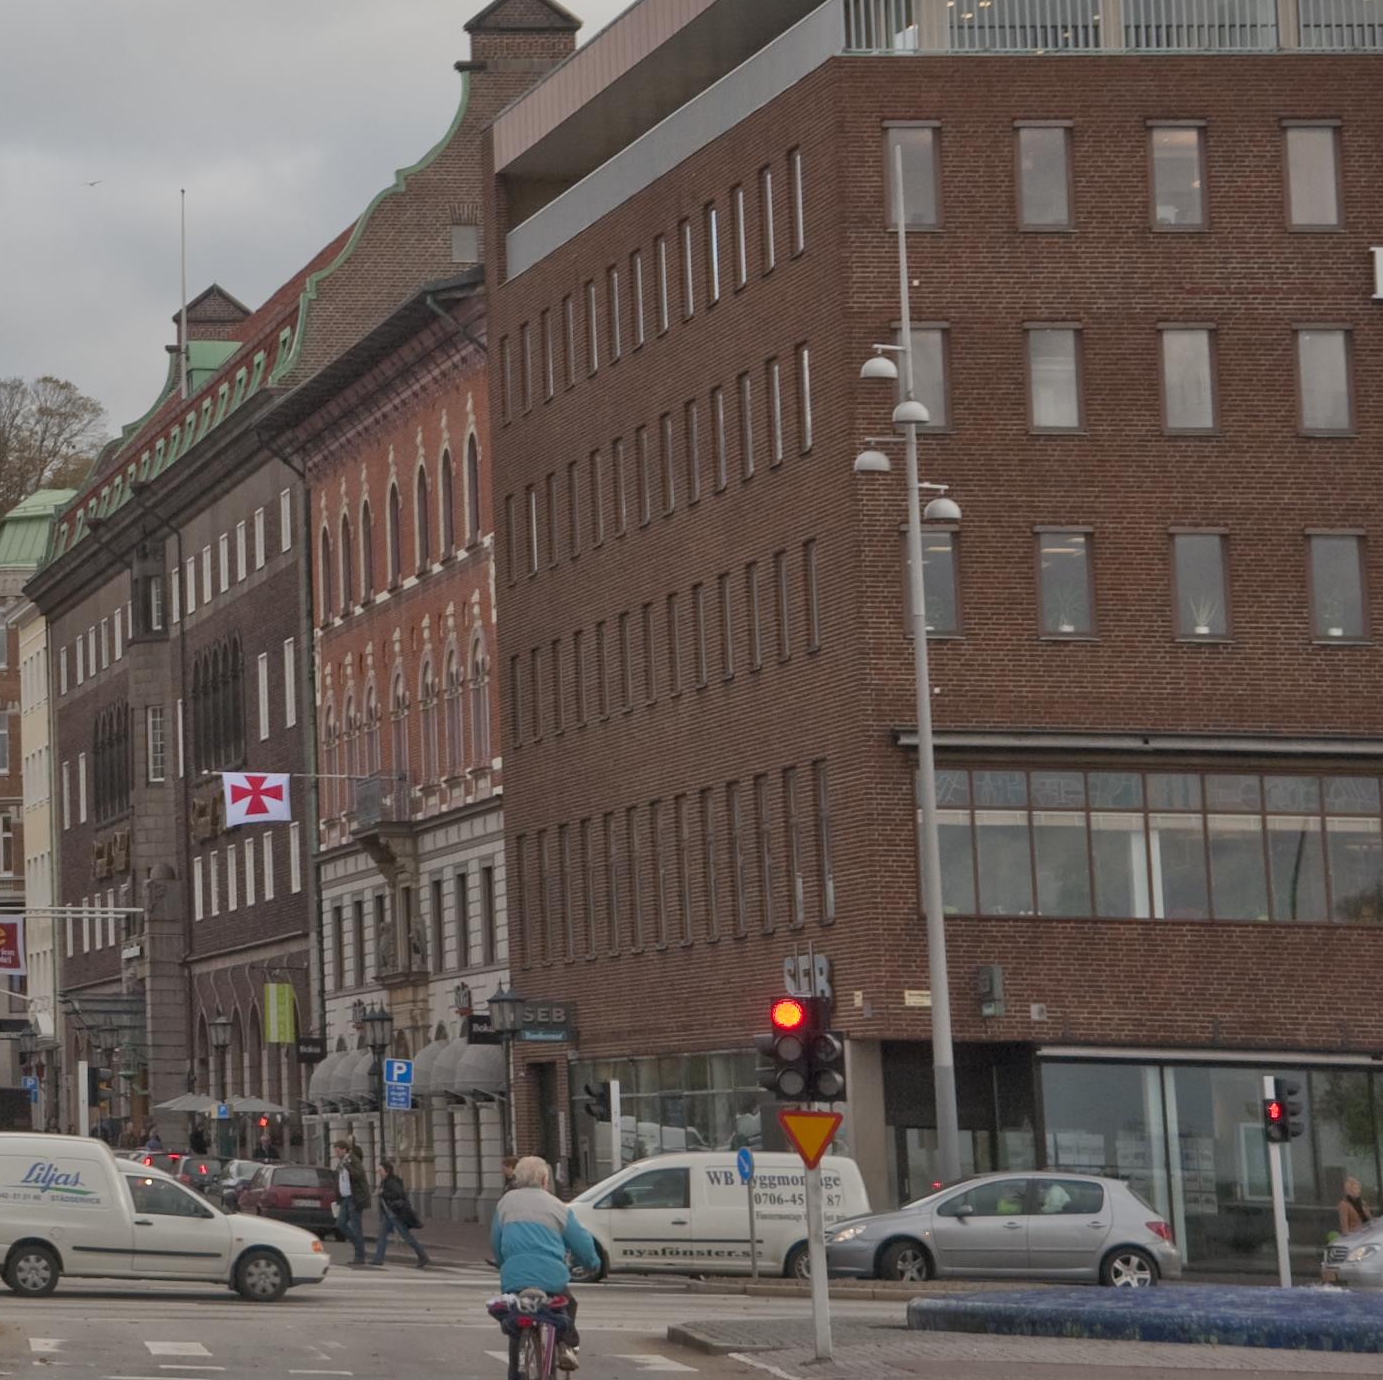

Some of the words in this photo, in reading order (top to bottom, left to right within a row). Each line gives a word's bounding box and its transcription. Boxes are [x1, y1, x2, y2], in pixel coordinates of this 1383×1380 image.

[523, 1006, 566, 1022] SEB
[393, 1062, 407, 1081] P
[21, 1162, 80, 1193] Liljas
[707, 1171, 733, 1186] WB
[740, 1173, 841, 1189] yggmonge
[754, 1193, 804, 1206] 0706-45
[827, 1195, 841, 1206] 87
